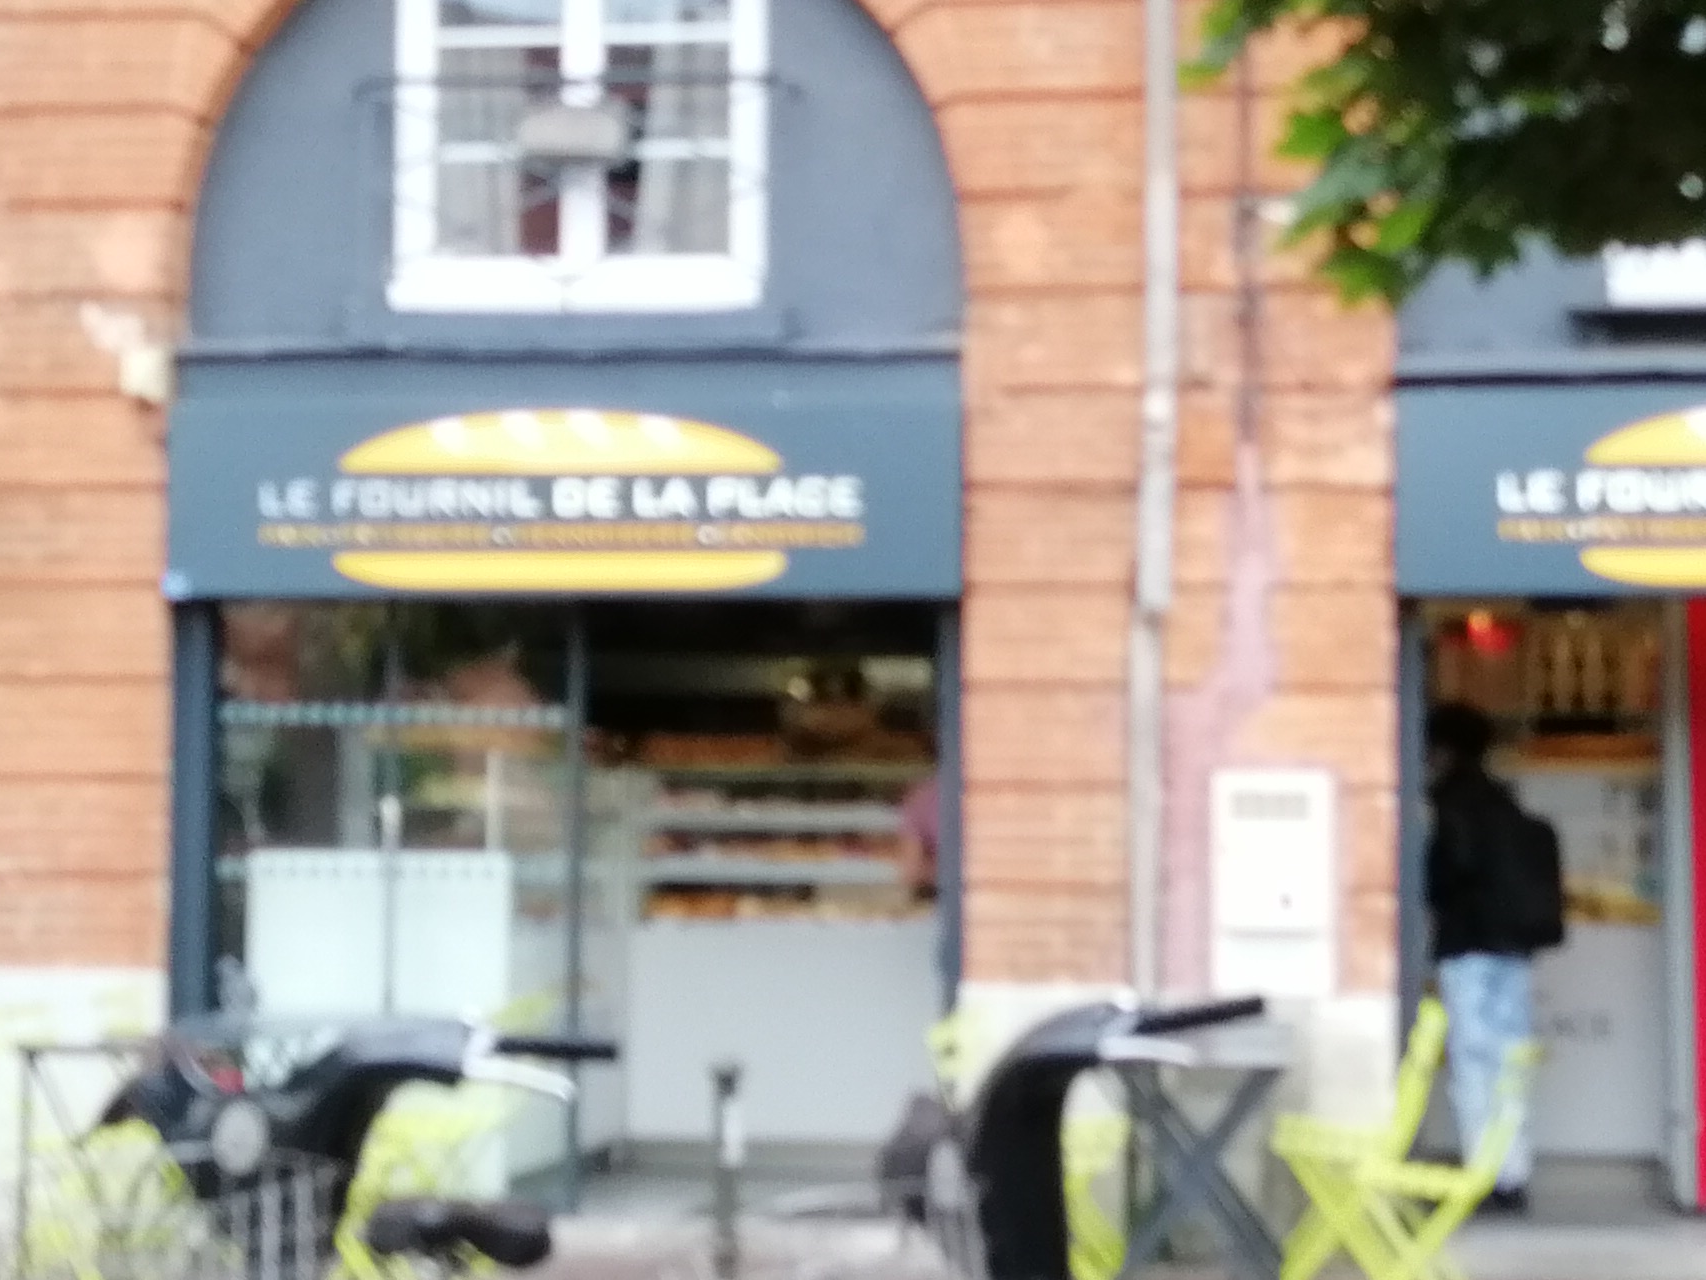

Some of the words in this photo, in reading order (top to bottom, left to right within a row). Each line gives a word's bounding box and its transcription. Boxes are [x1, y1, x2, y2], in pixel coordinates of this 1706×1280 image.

[257, 476, 318, 519] LE
[330, 477, 542, 519] FOURNIL
[551, 475, 621, 519] DE
[632, 475, 697, 519] LA
[705, 474, 865, 518] PLACE
[1496, 469, 1566, 513] LE
